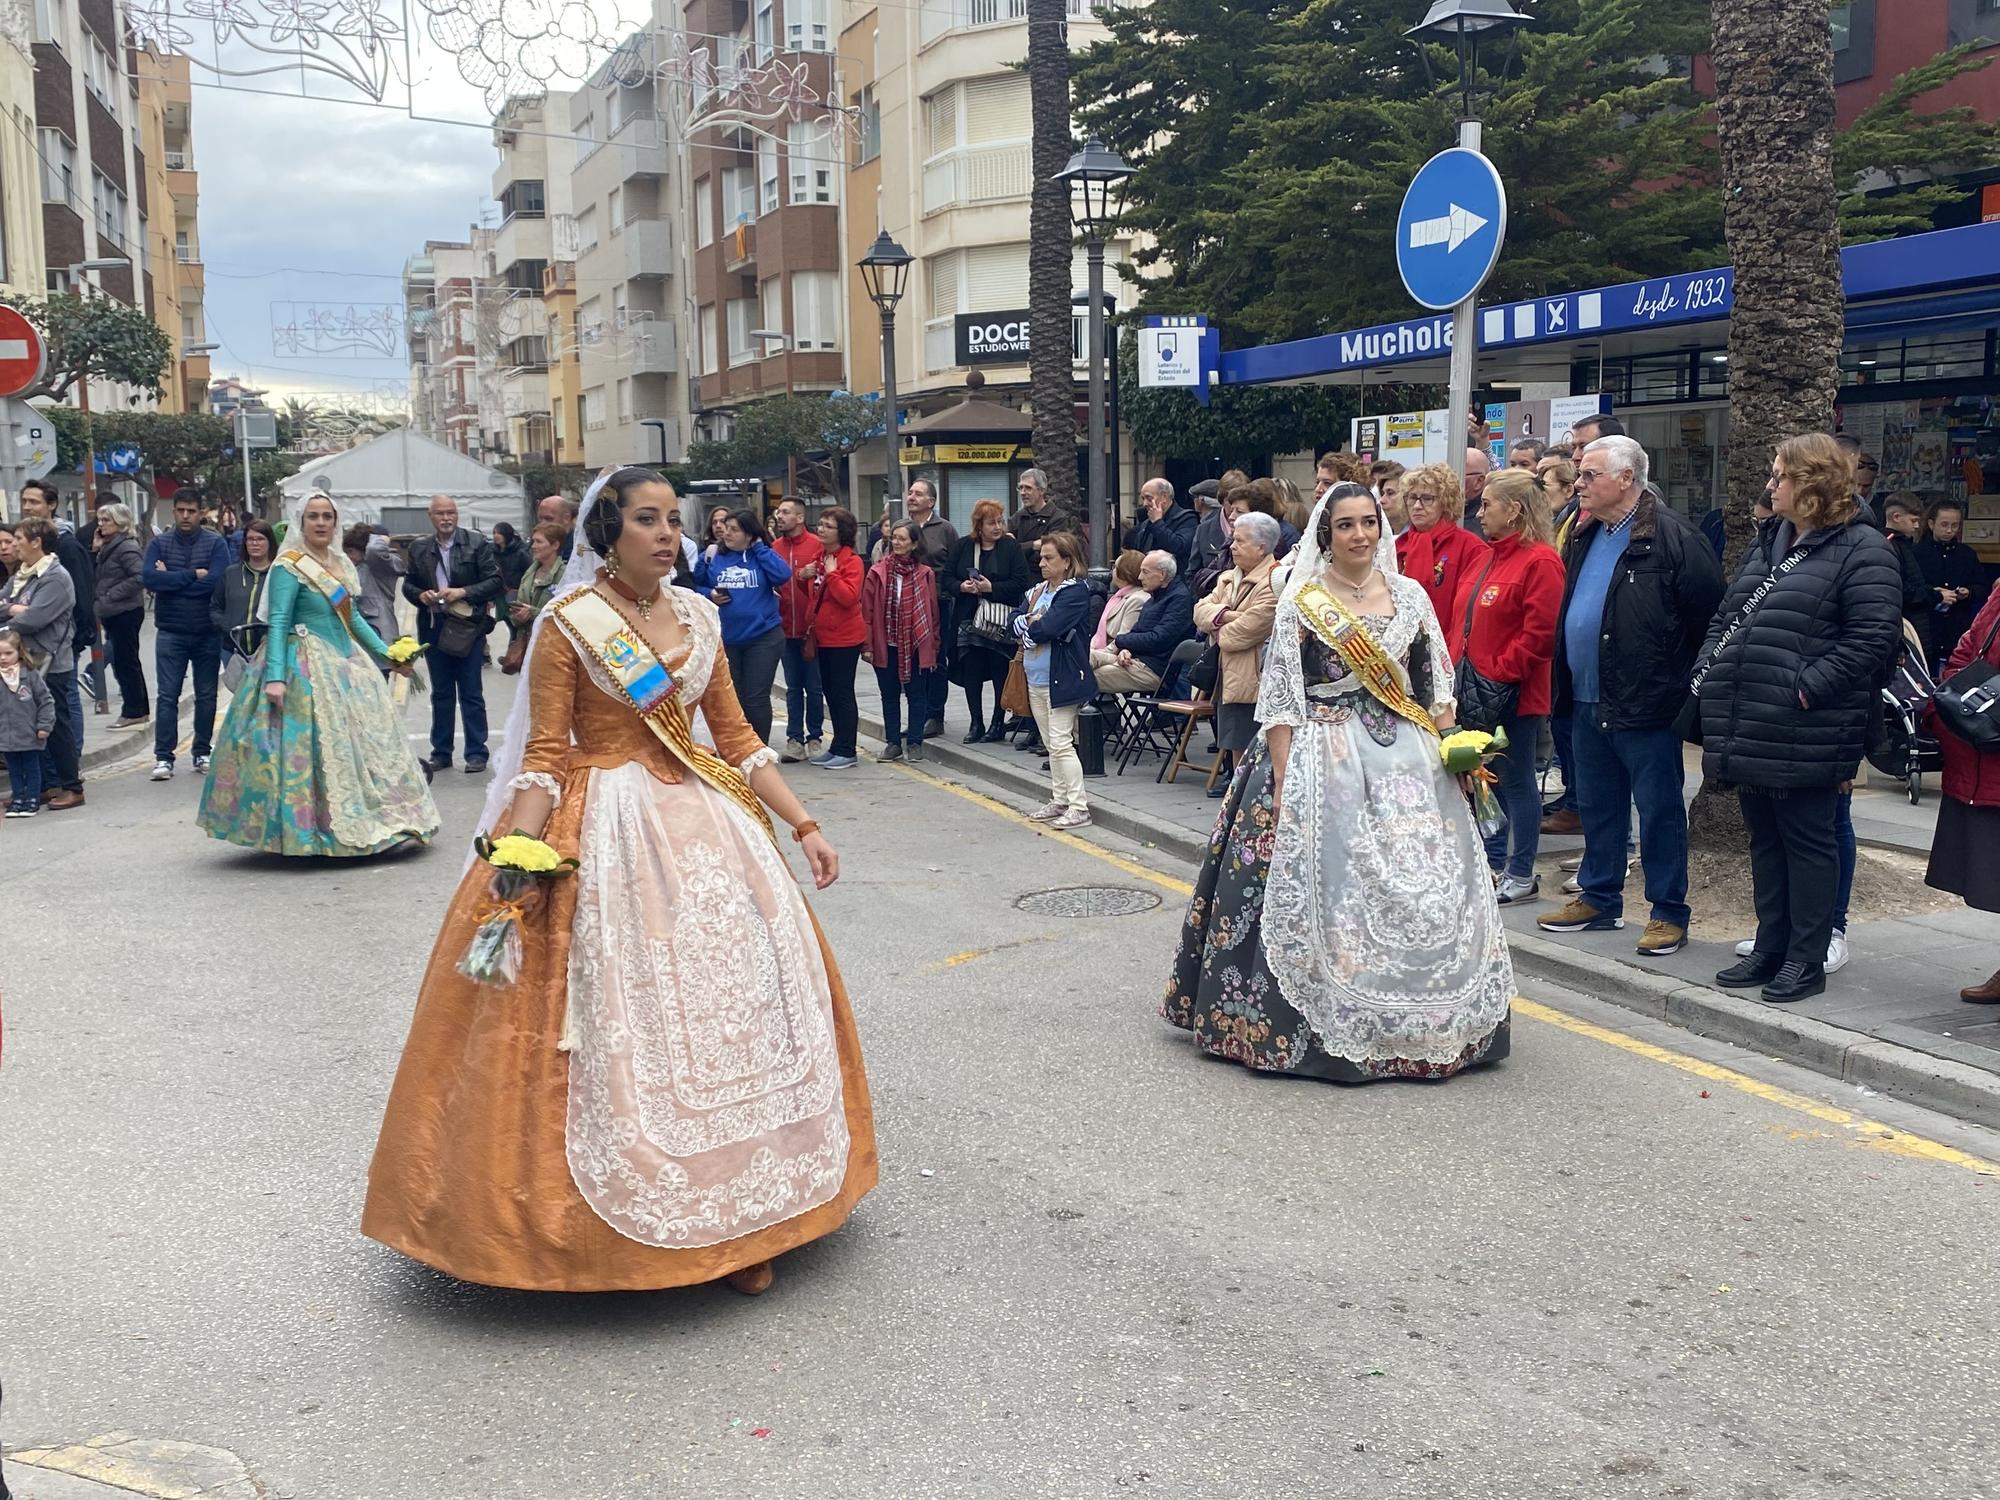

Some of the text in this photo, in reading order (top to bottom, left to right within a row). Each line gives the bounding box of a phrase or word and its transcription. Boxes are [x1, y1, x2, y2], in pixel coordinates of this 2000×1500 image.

[1632, 276, 1726, 320] desde 1932
[968, 321, 1030, 345] DOCE
[968, 342, 1009, 354] ESTUDIO
[1341, 319, 1454, 363] Muchola
[1713, 616, 1741, 658] BIMBAY
[1742, 566, 1778, 614] BIMBAY
